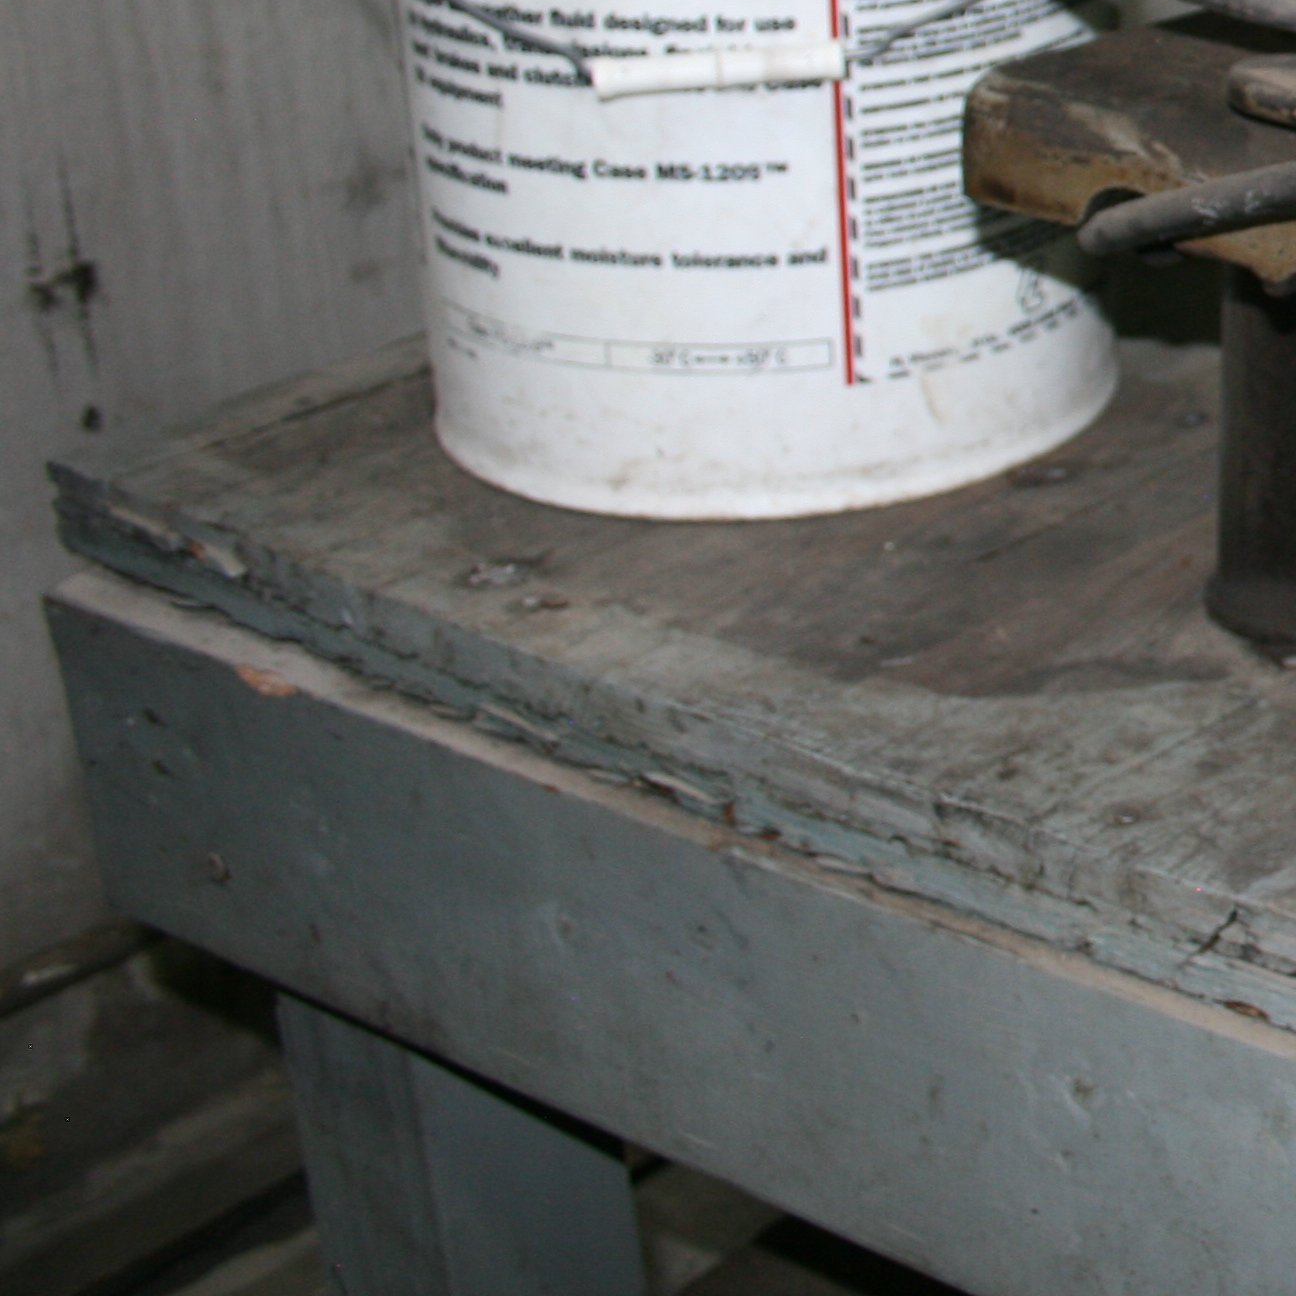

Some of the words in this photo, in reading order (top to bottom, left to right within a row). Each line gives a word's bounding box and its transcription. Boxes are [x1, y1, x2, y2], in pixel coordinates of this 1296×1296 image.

[551, 9, 595, 29] fluid
[604, 13, 708, 35] designed
[716, 14, 746, 32] for
[755, 17, 796, 32] use
[508, 153, 588, 181] meeting
[592, 159, 647, 180] Case
[571, 247, 663, 268] moisture
[671, 251, 779, 269] tolerance
[787, 245, 827, 266] and
